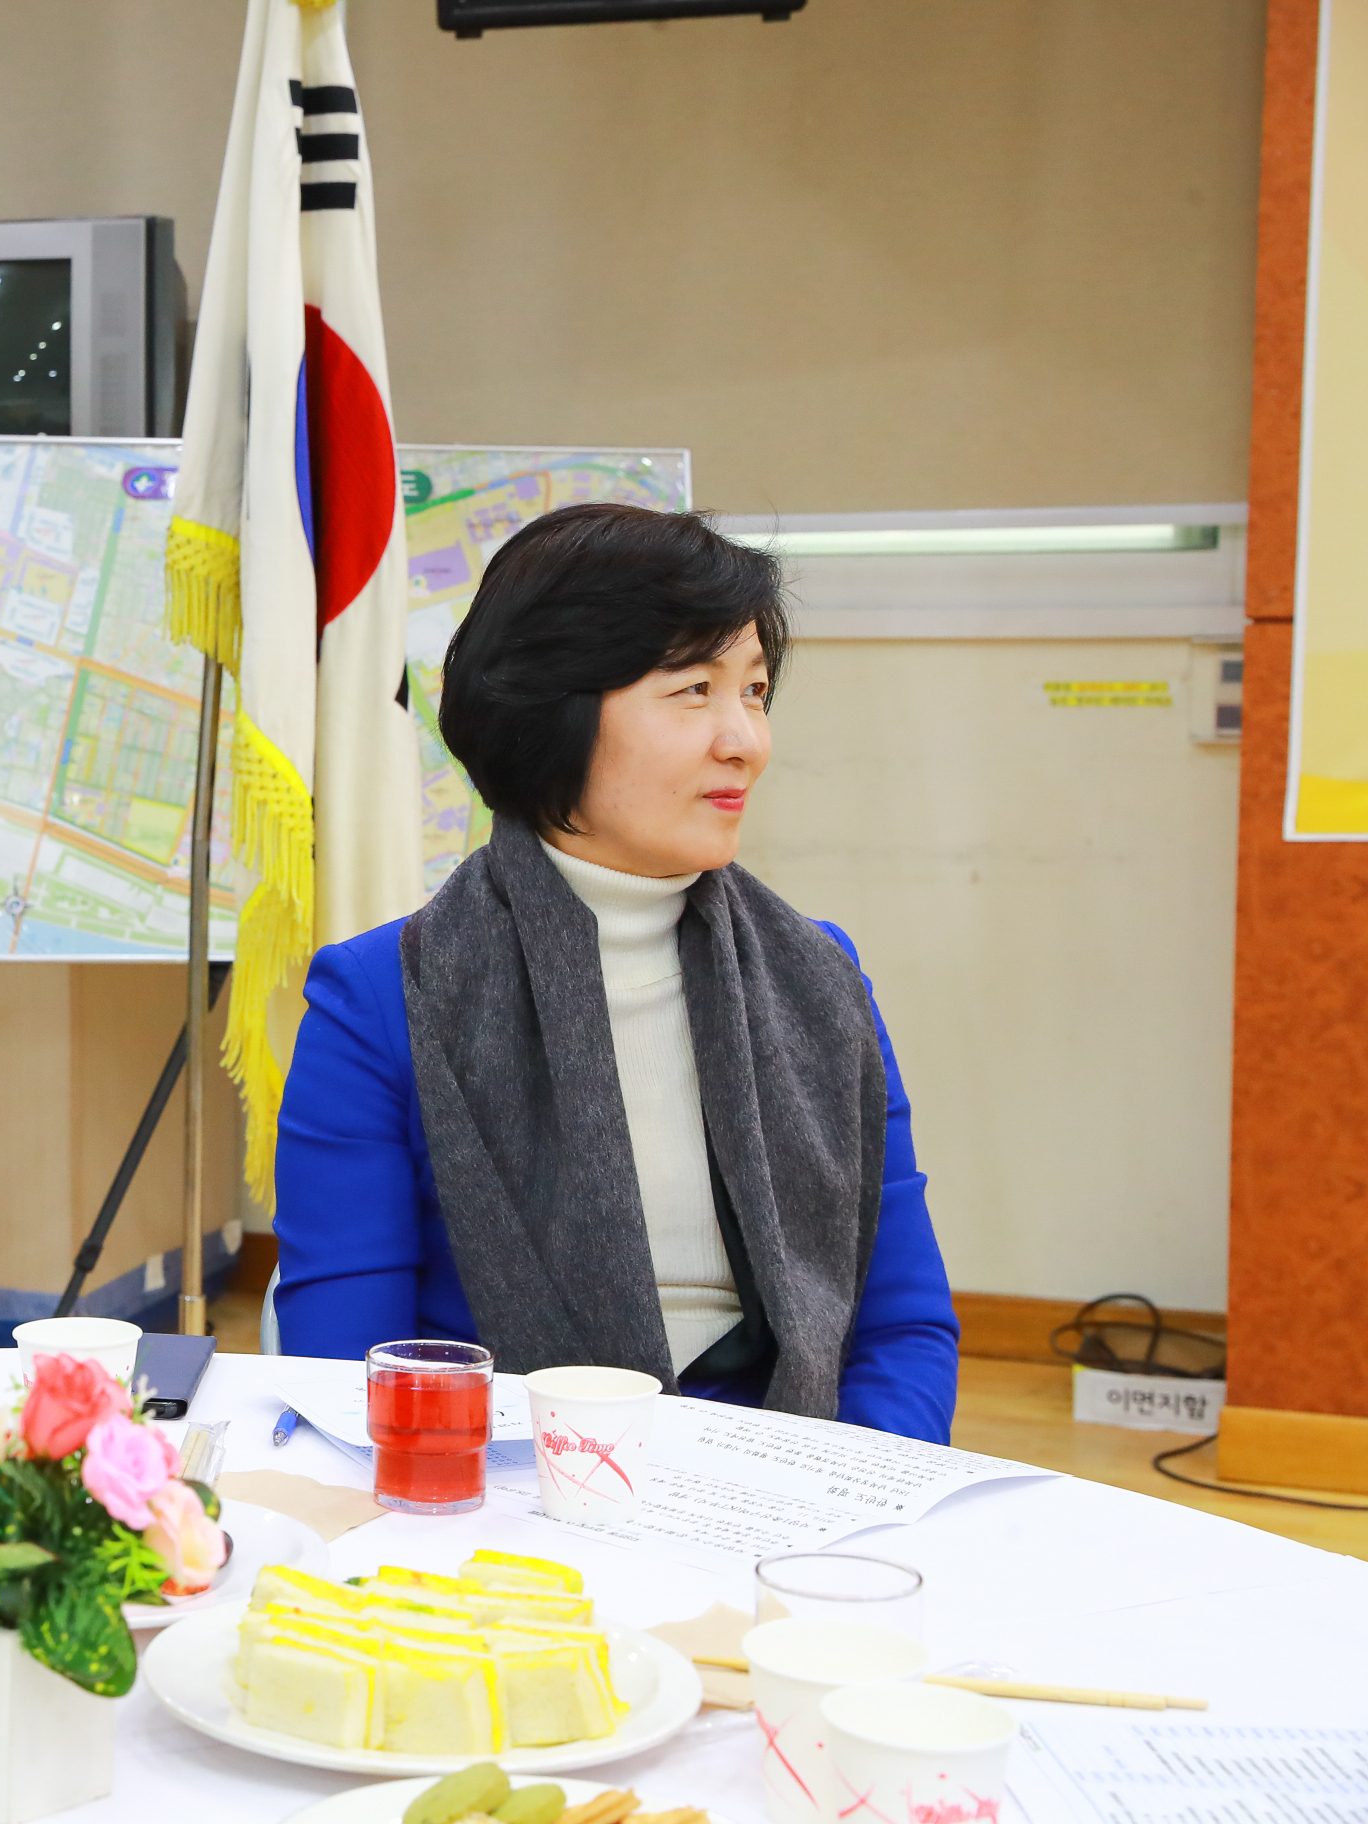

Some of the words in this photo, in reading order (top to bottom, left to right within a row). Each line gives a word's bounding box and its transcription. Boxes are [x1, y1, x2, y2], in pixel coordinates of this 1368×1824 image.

[541, 1431, 577, 1455] Coffee
[578, 1438, 615, 1455] Time
[826, 1485, 850, 1498] 평화
[854, 1492, 888, 1508] 한반도
